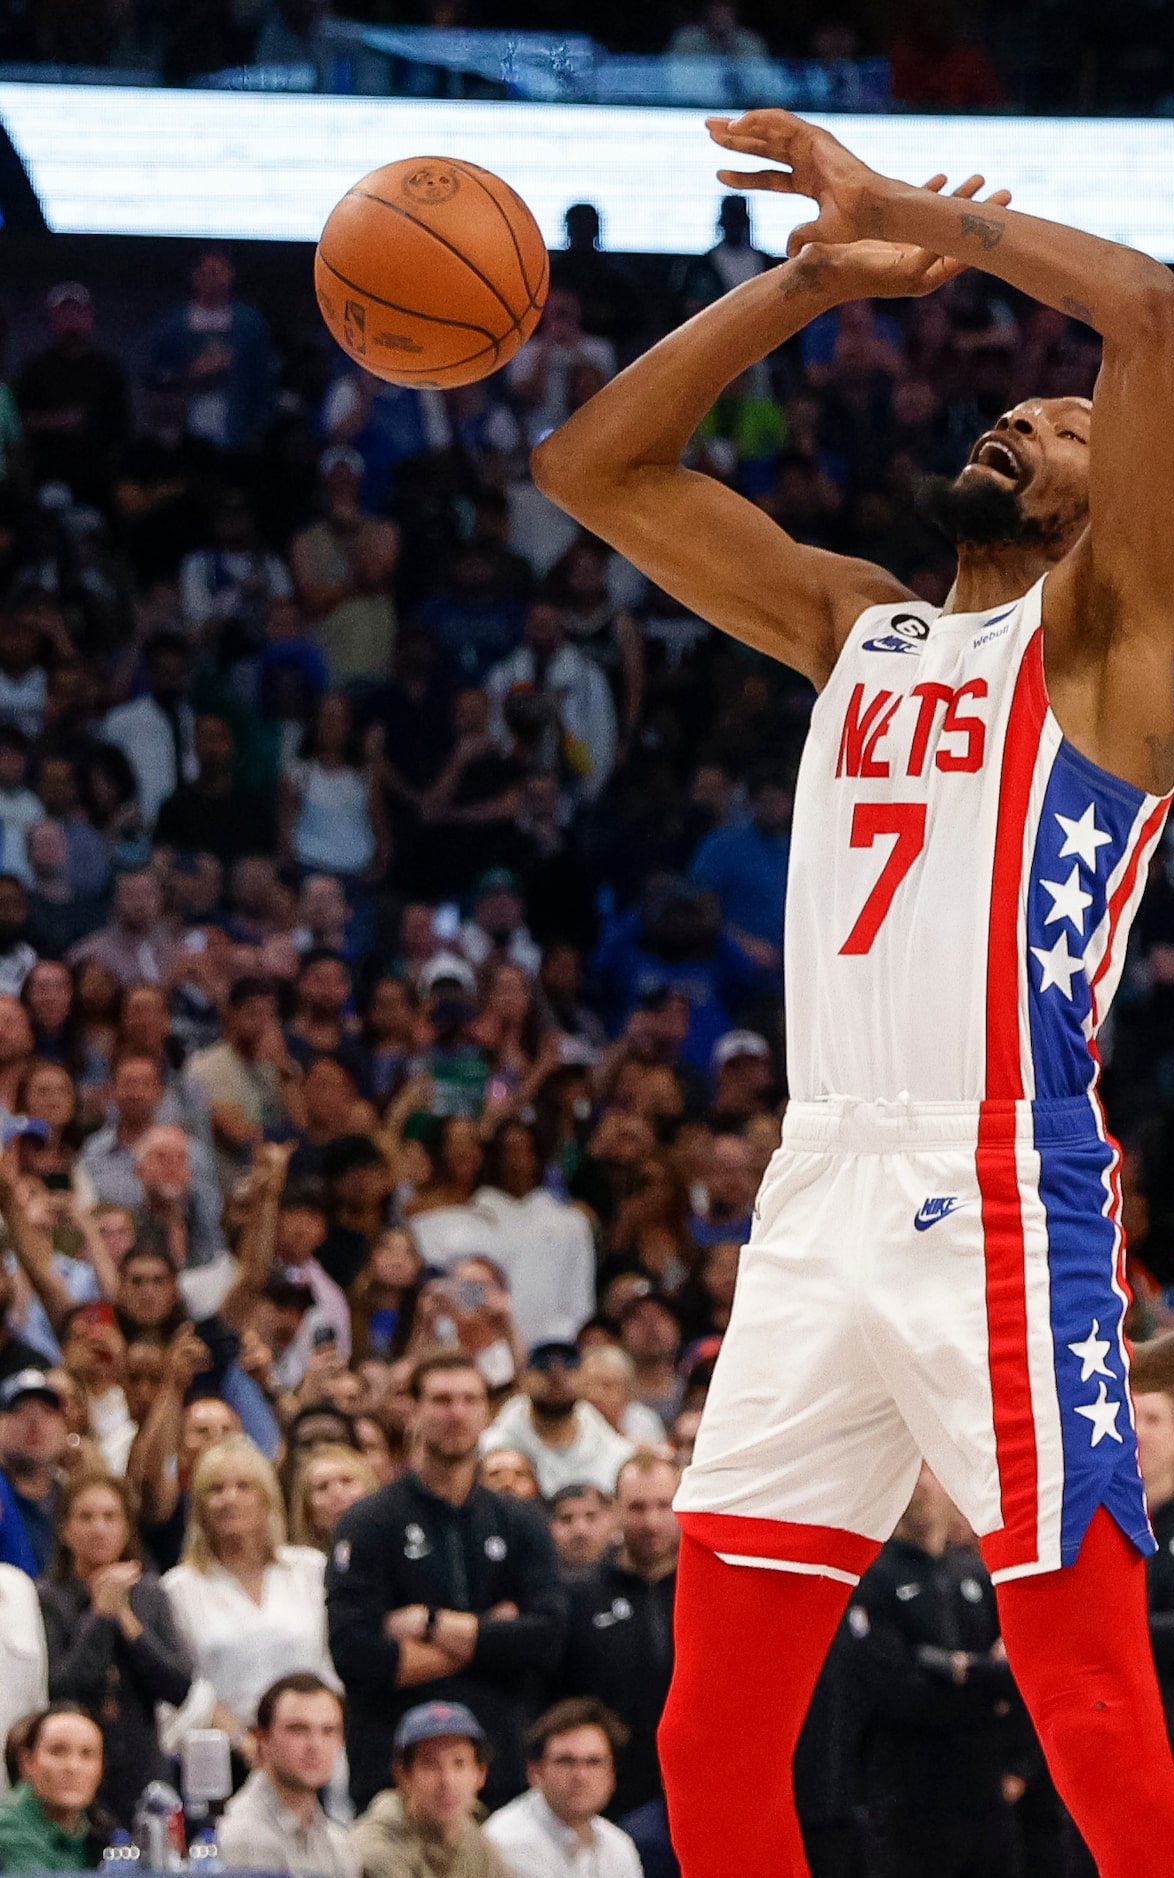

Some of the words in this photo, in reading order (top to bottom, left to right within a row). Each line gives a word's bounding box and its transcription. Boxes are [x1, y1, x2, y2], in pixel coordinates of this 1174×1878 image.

[896, 618, 926, 638] 6
[973, 624, 1010, 649] Webull
[835, 677, 988, 779] NETS
[838, 803, 927, 955] 7
[920, 1197, 958, 1217] NIKE
